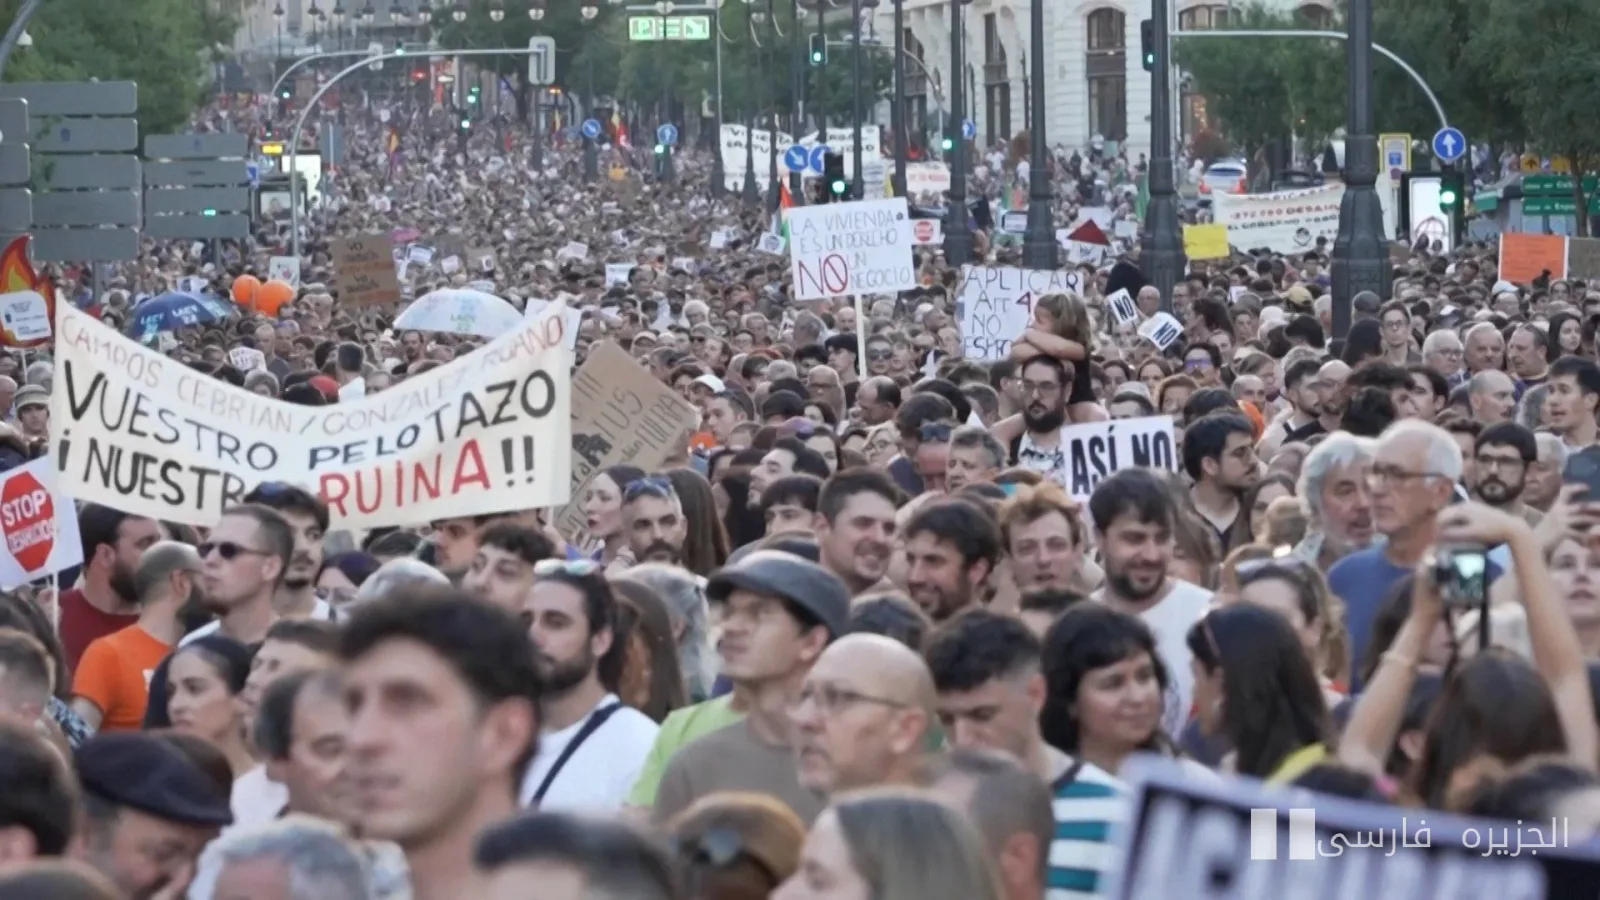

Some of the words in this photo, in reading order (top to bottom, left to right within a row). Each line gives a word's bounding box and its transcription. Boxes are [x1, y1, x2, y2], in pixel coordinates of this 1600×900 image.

[790, 218, 817, 236] LA
[825, 210, 895, 231] VIVIENDA
[798, 254, 848, 296] NO
[850, 266, 911, 290] NEGOCIO
[964, 266, 1079, 295] APLICAR
[1114, 294, 1135, 321] NO
[972, 313, 1001, 336] NO
[1152, 321, 1178, 347] NO
[61, 315, 163, 388] CAMPOS
[177, 373, 291, 433] CEBRIAN
[481, 314, 563, 371] RUANO
[64, 360, 278, 471] VUESTRO
[308, 369, 556, 470] PELOTAZO
[58, 428, 246, 516] ¡NUESTR
[1071, 425, 1117, 495] ASÍ
[1132, 430, 1173, 474] NO
[2, 489, 47, 527] STOP
